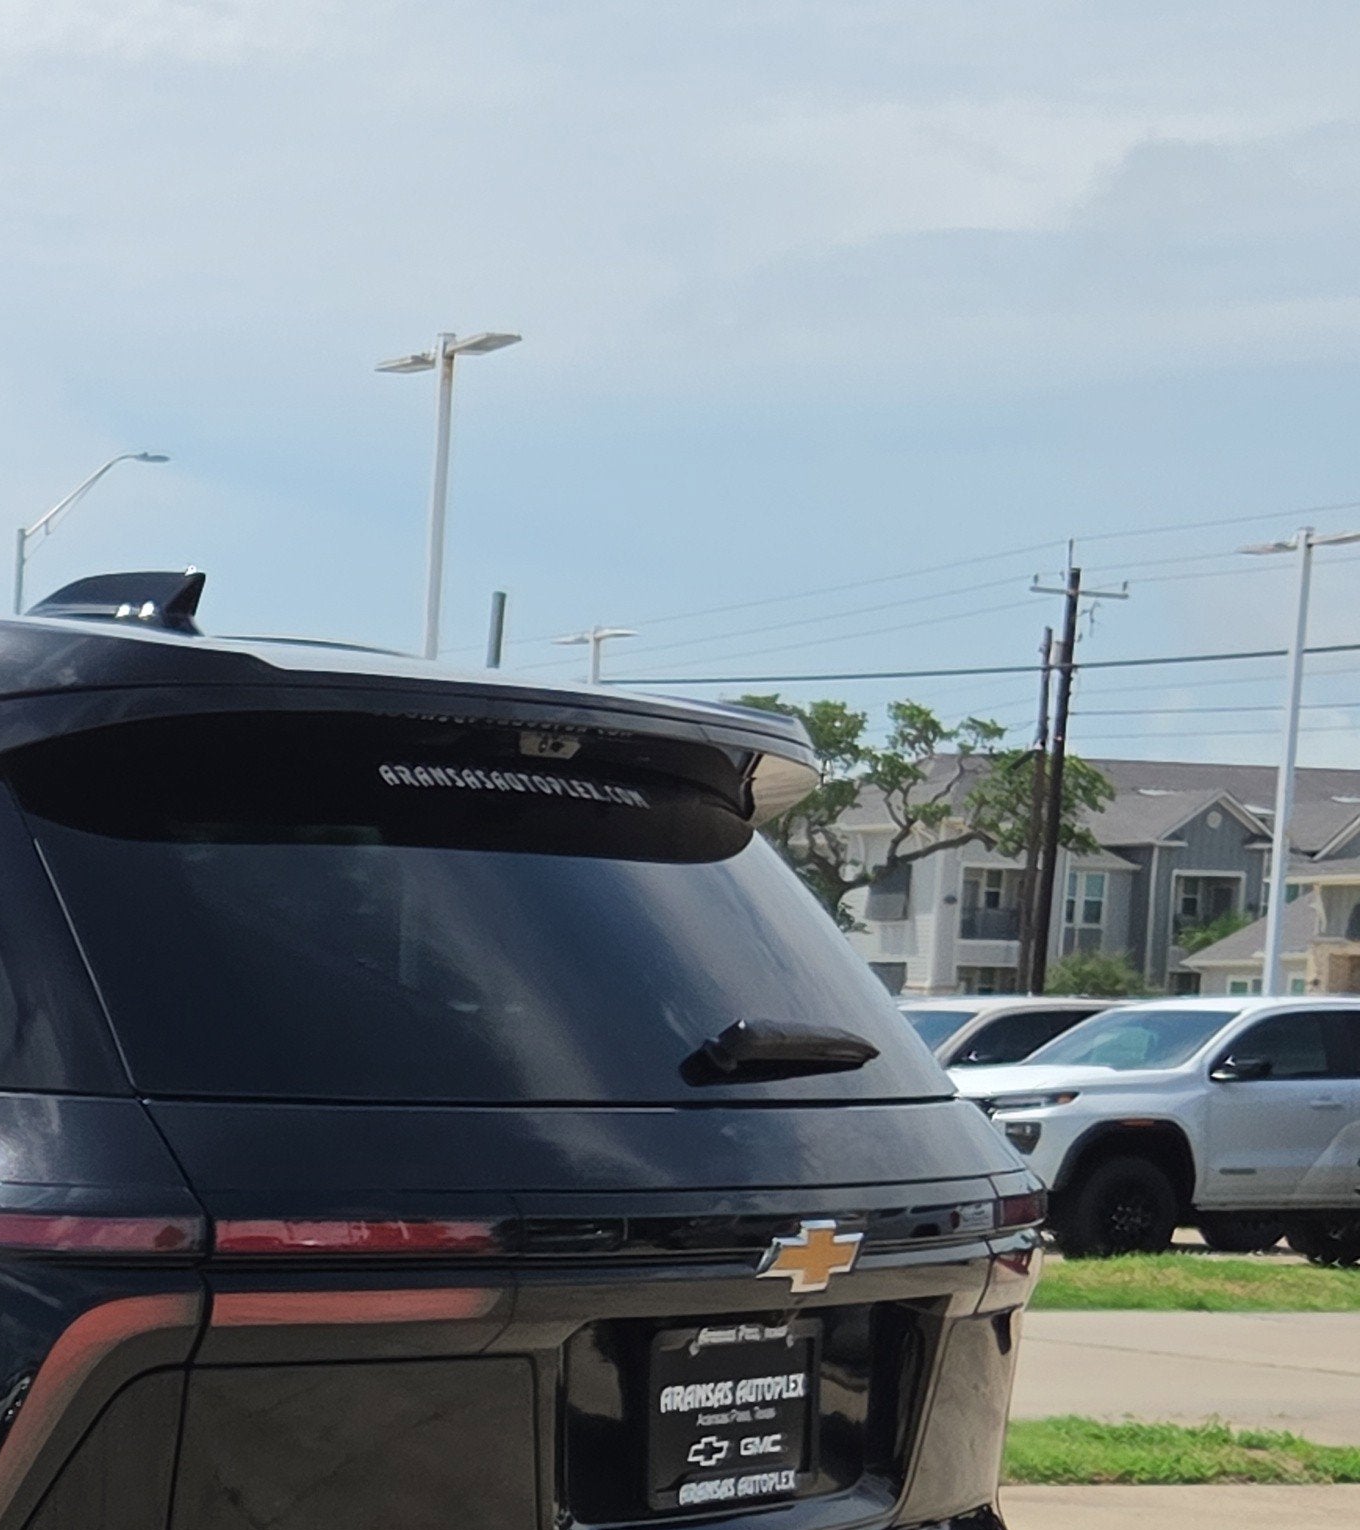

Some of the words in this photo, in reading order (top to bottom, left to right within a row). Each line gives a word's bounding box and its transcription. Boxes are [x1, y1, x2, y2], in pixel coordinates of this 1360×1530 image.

[660, 1381, 733, 1413] ARANSAS
[736, 1373, 805, 1405] AUTOPLEX
[739, 1434, 782, 1456] GMC
[679, 1478, 735, 1505] ARANSAS
[737, 1470, 795, 1496] AUTOPLEX
